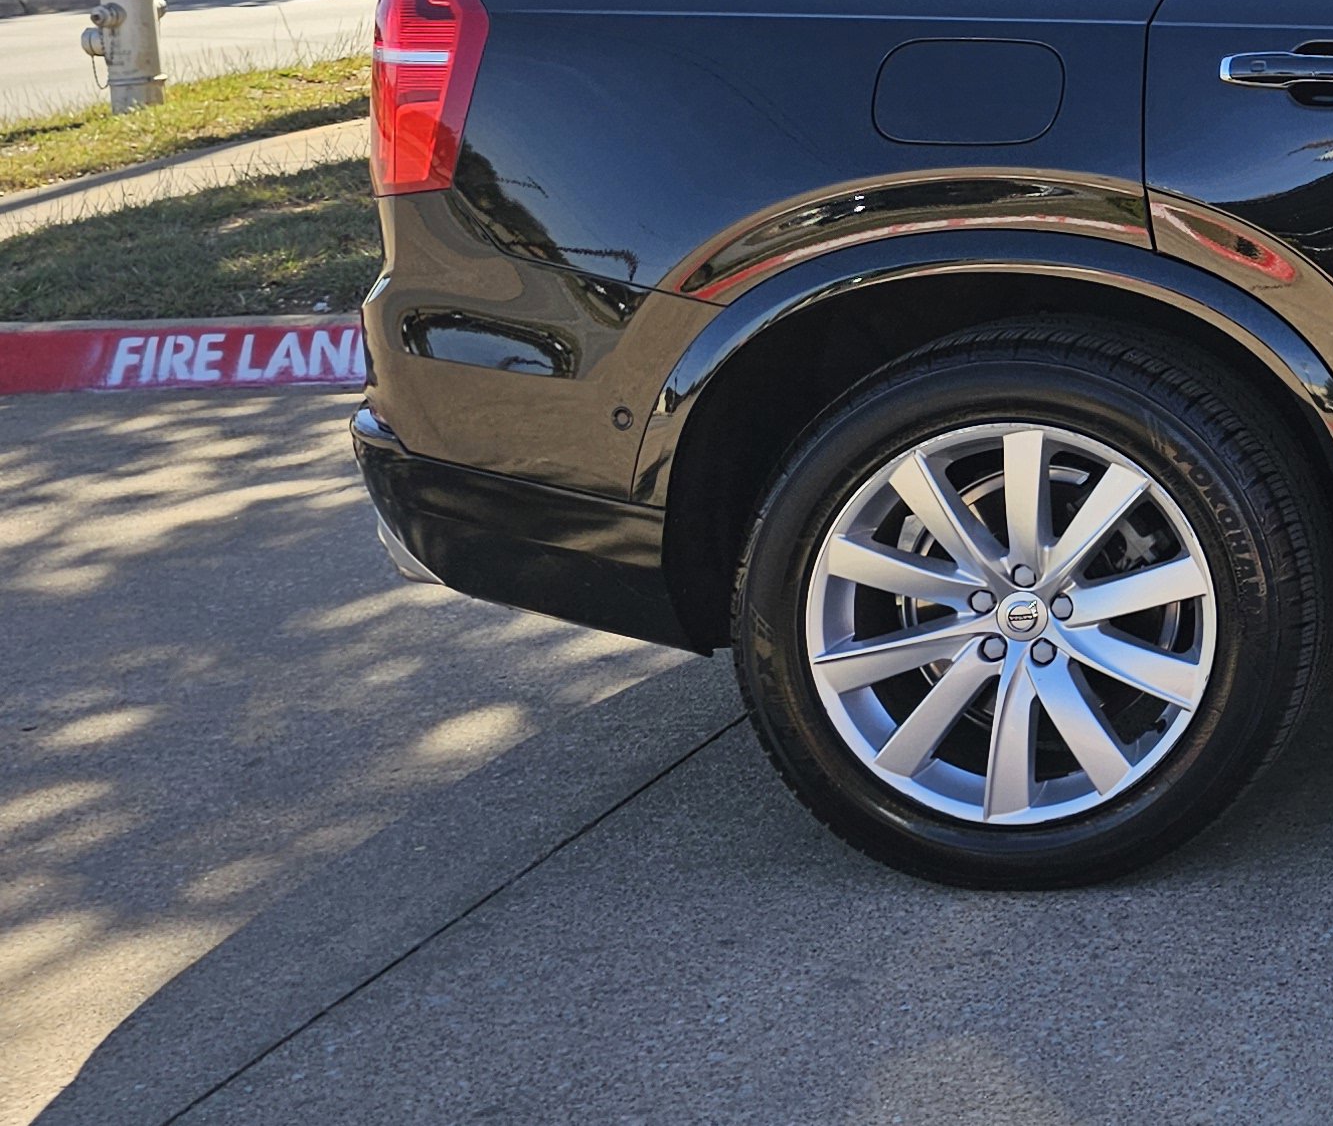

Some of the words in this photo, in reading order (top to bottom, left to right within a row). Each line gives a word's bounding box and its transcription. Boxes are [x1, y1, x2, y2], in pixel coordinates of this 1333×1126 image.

[106, 333, 226, 386] FIRE
[232, 329, 367, 381] LAN
[1172, 442, 1264, 626] YOKOHAM
